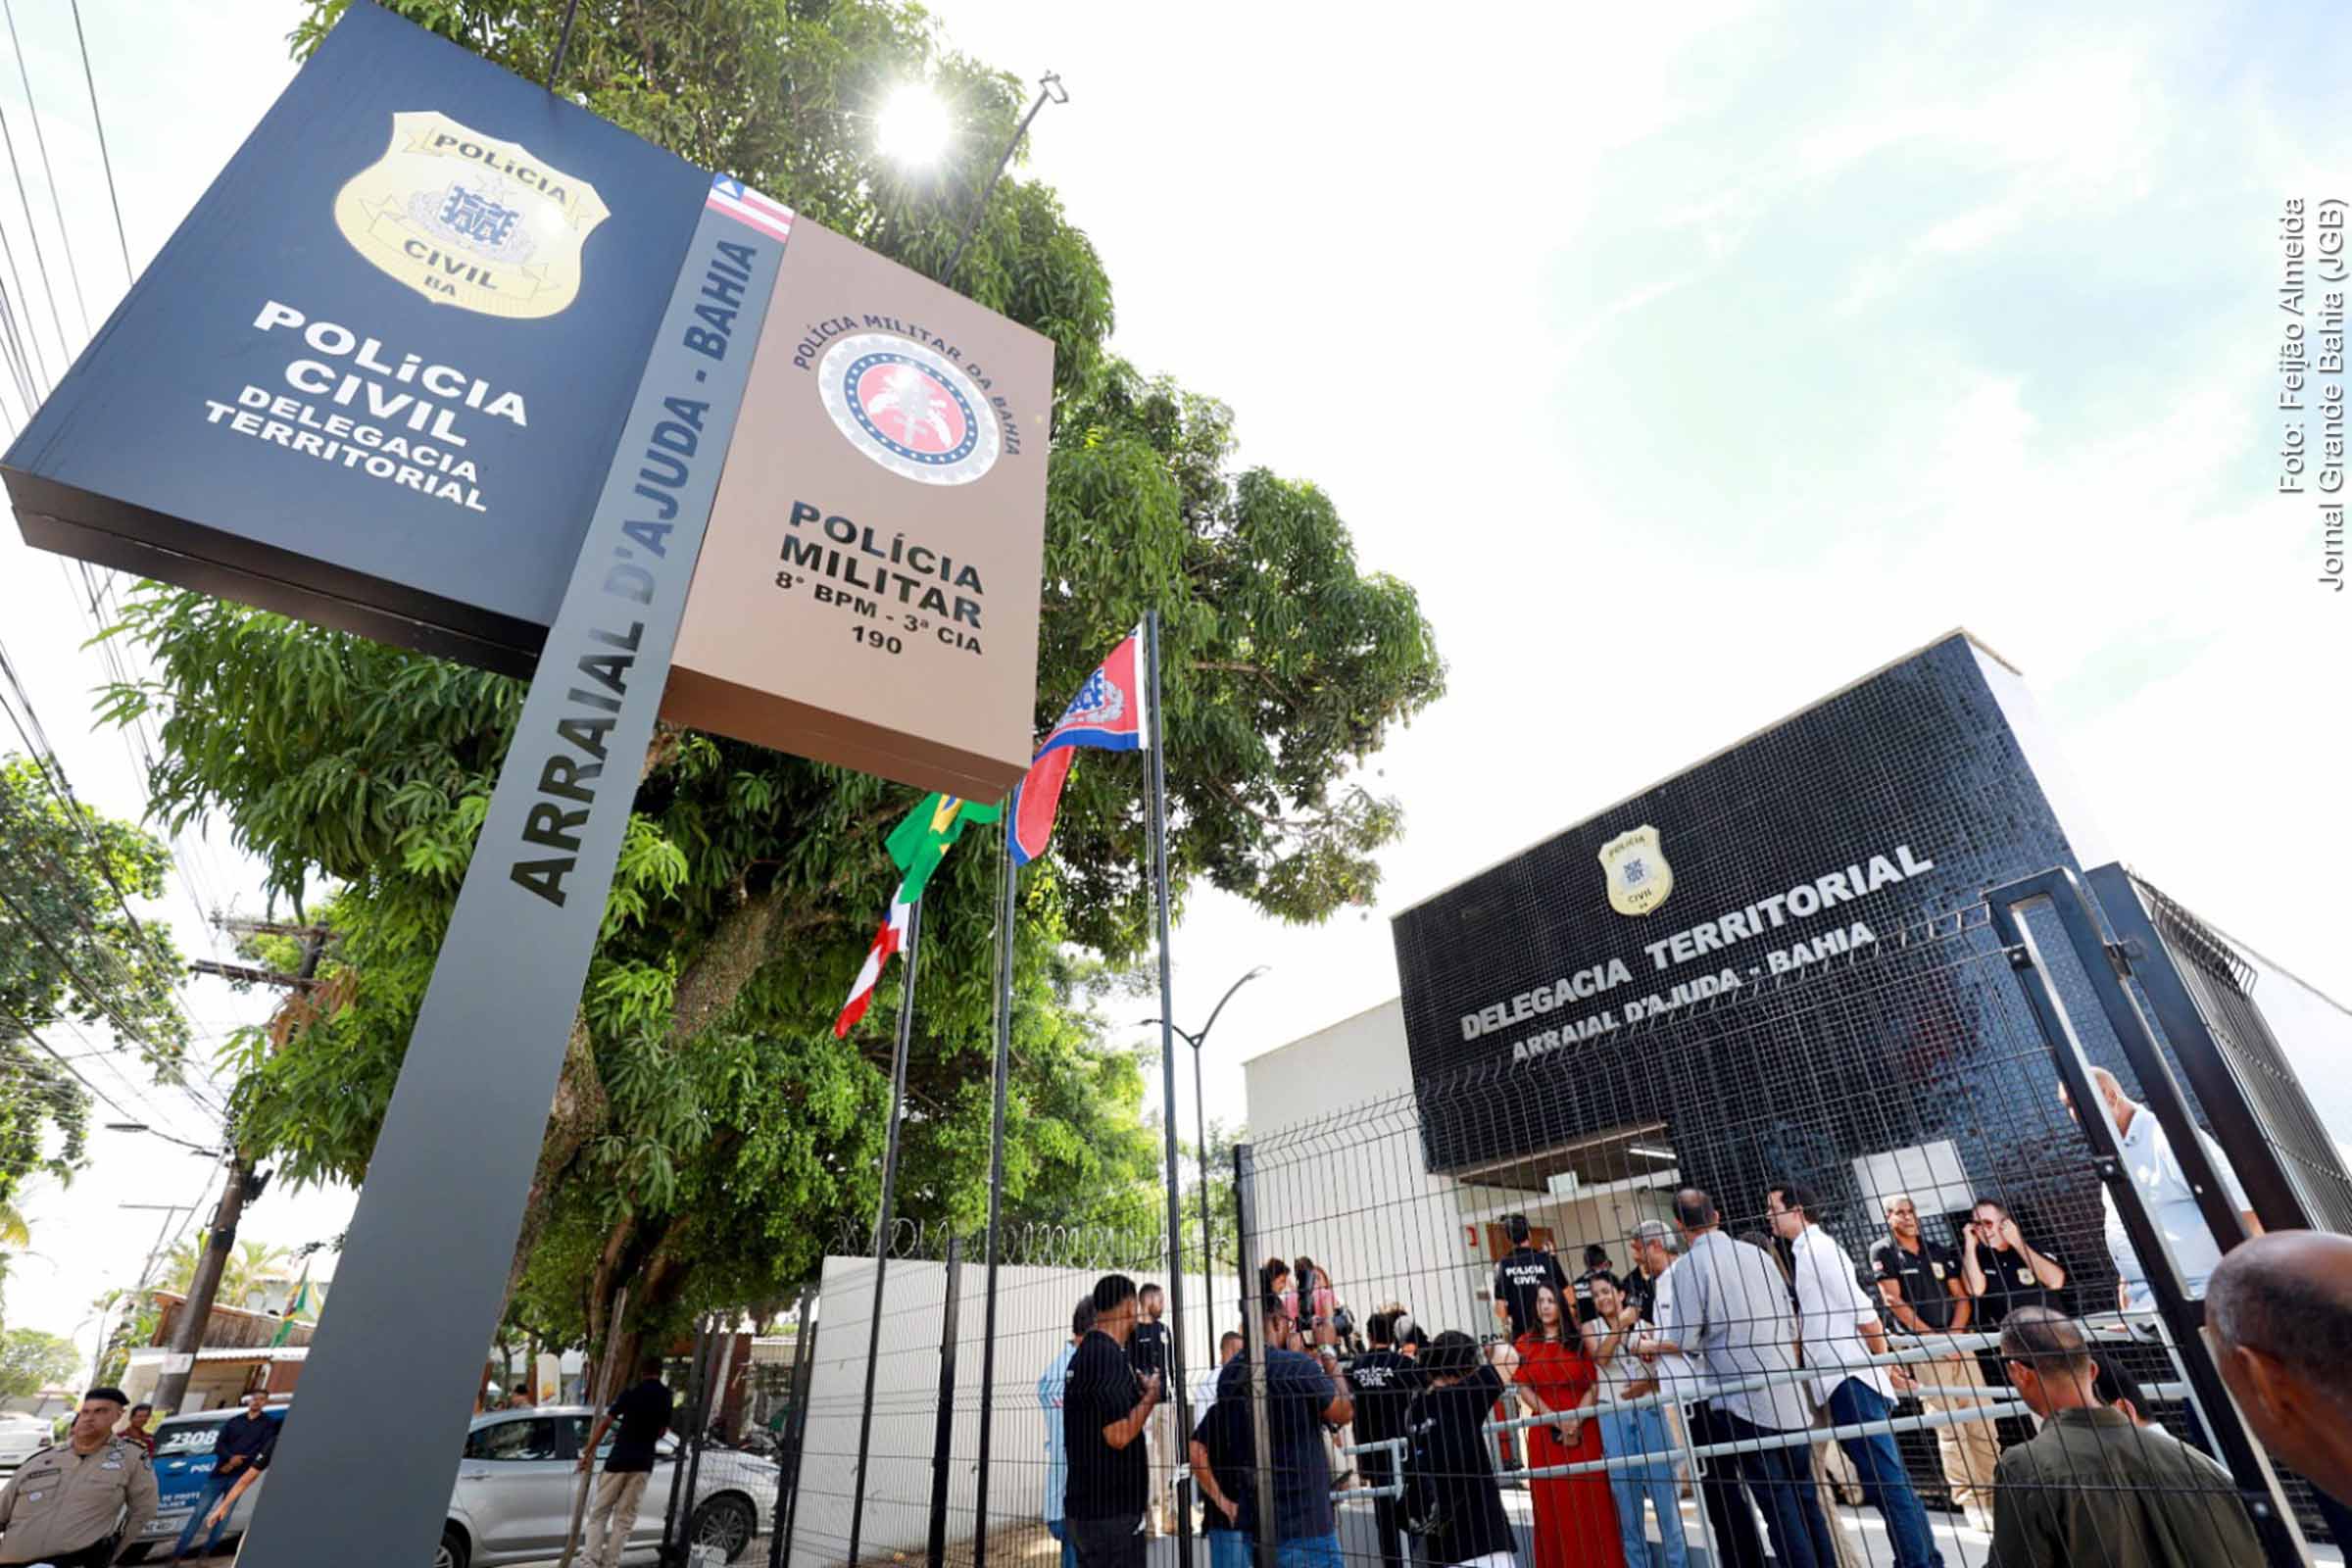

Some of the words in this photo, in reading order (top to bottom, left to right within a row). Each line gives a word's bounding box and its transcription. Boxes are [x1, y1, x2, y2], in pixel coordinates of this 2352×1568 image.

[403, 239, 498, 289] CIVIL
[423, 274, 457, 297] BA
[237, 384, 478, 483] DELEGACIA
[284, 359, 467, 448] CIVIL
[793, 316, 858, 371] POLÍCIA
[862, 314, 962, 362] MILITAR
[965, 363, 993, 391] DA
[991, 395, 1021, 457] BAHIA
[204, 400, 487, 512] TERRITORIAL
[509, 620, 646, 908] ARRAIAL
[604, 393, 711, 607] D'AJUDA
[682, 238, 760, 365] BAHIA
[780, 532, 982, 629] MILITAR
[789, 500, 984, 596] POLÍCIA
[813, 582, 878, 619] BPM
[936, 625, 983, 656] CIA
[851, 624, 903, 655] 190
[1644, 844, 1935, 970] TERRITORIAL
[1460, 957, 1634, 1042] DELEGACIA
[1512, 1010, 1621, 1060] ARRAIAL
[1767, 921, 1877, 976] BAHIA
[167, 1429, 220, 1447] 2308
